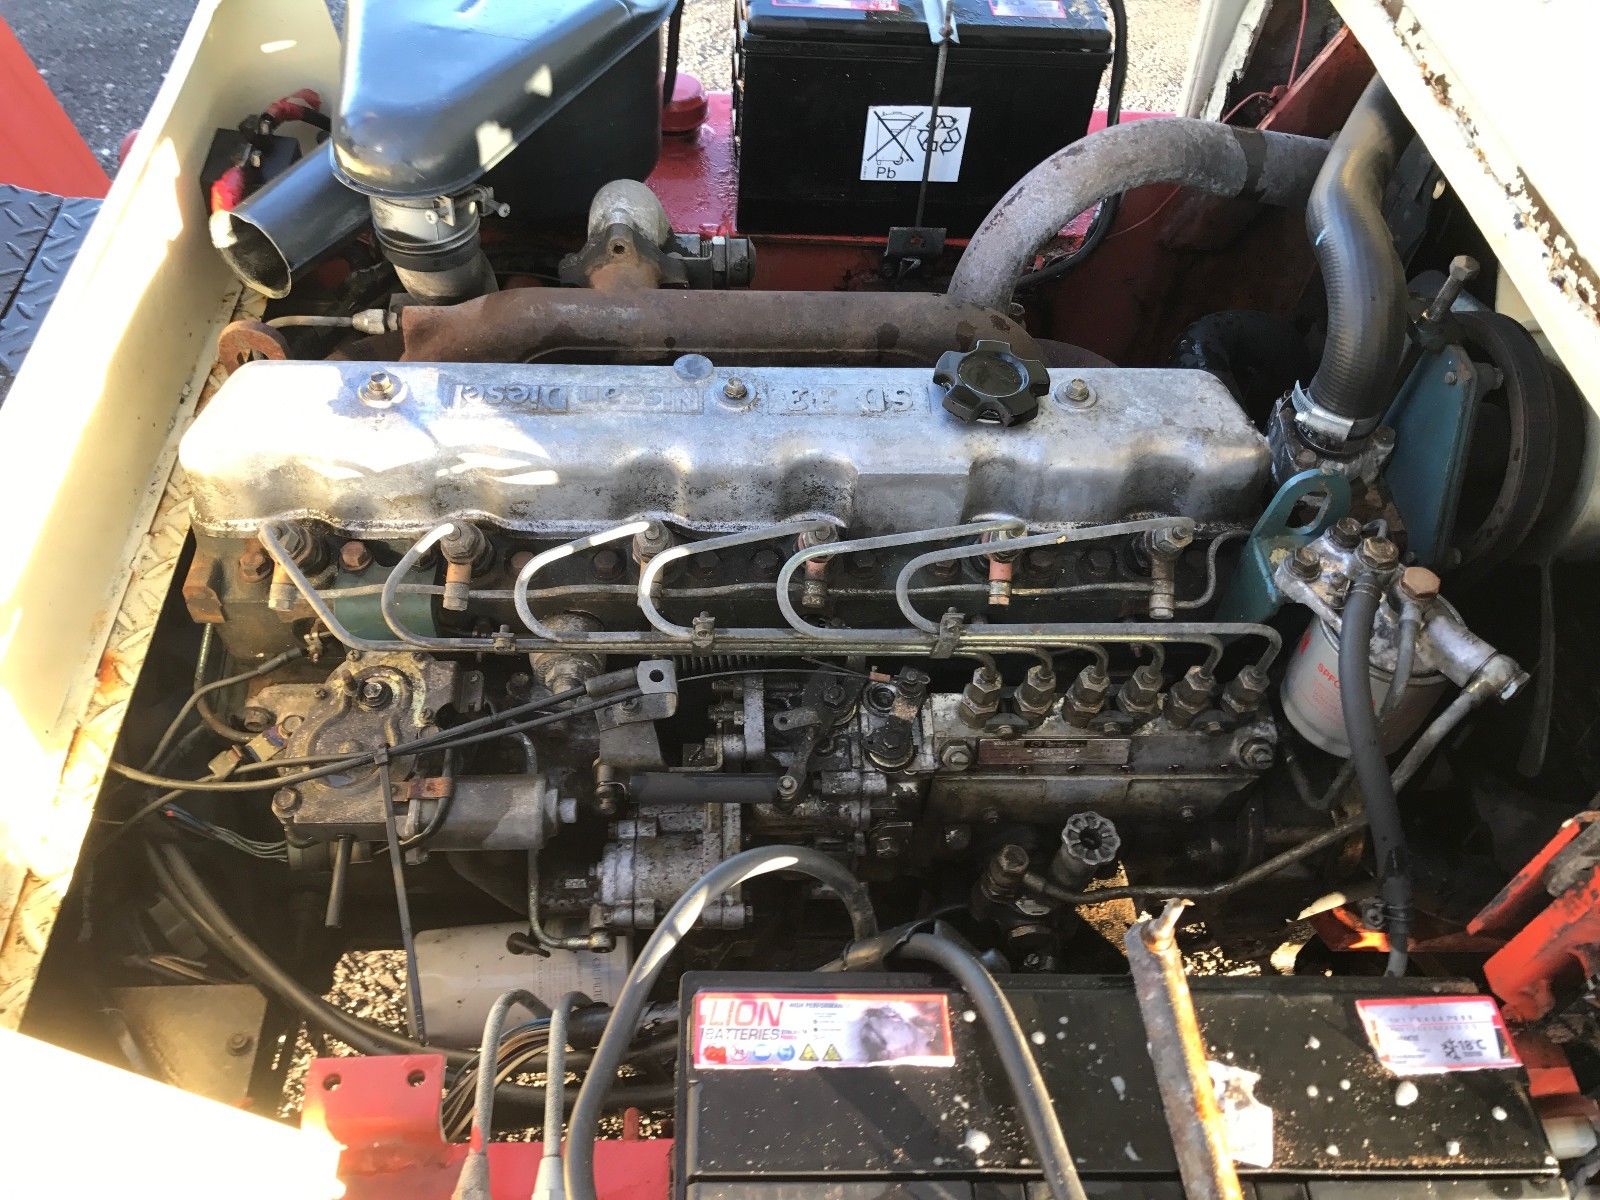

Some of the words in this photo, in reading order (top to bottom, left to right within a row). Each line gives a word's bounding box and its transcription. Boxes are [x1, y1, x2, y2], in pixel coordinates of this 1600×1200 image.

[876, 166, 897, 179] Pb
[453, 384, 568, 411] Diesel
[859, 386, 914, 412] SD
[709, 1000, 784, 1027] LION
[705, 1028, 780, 1041] BATTERIES
